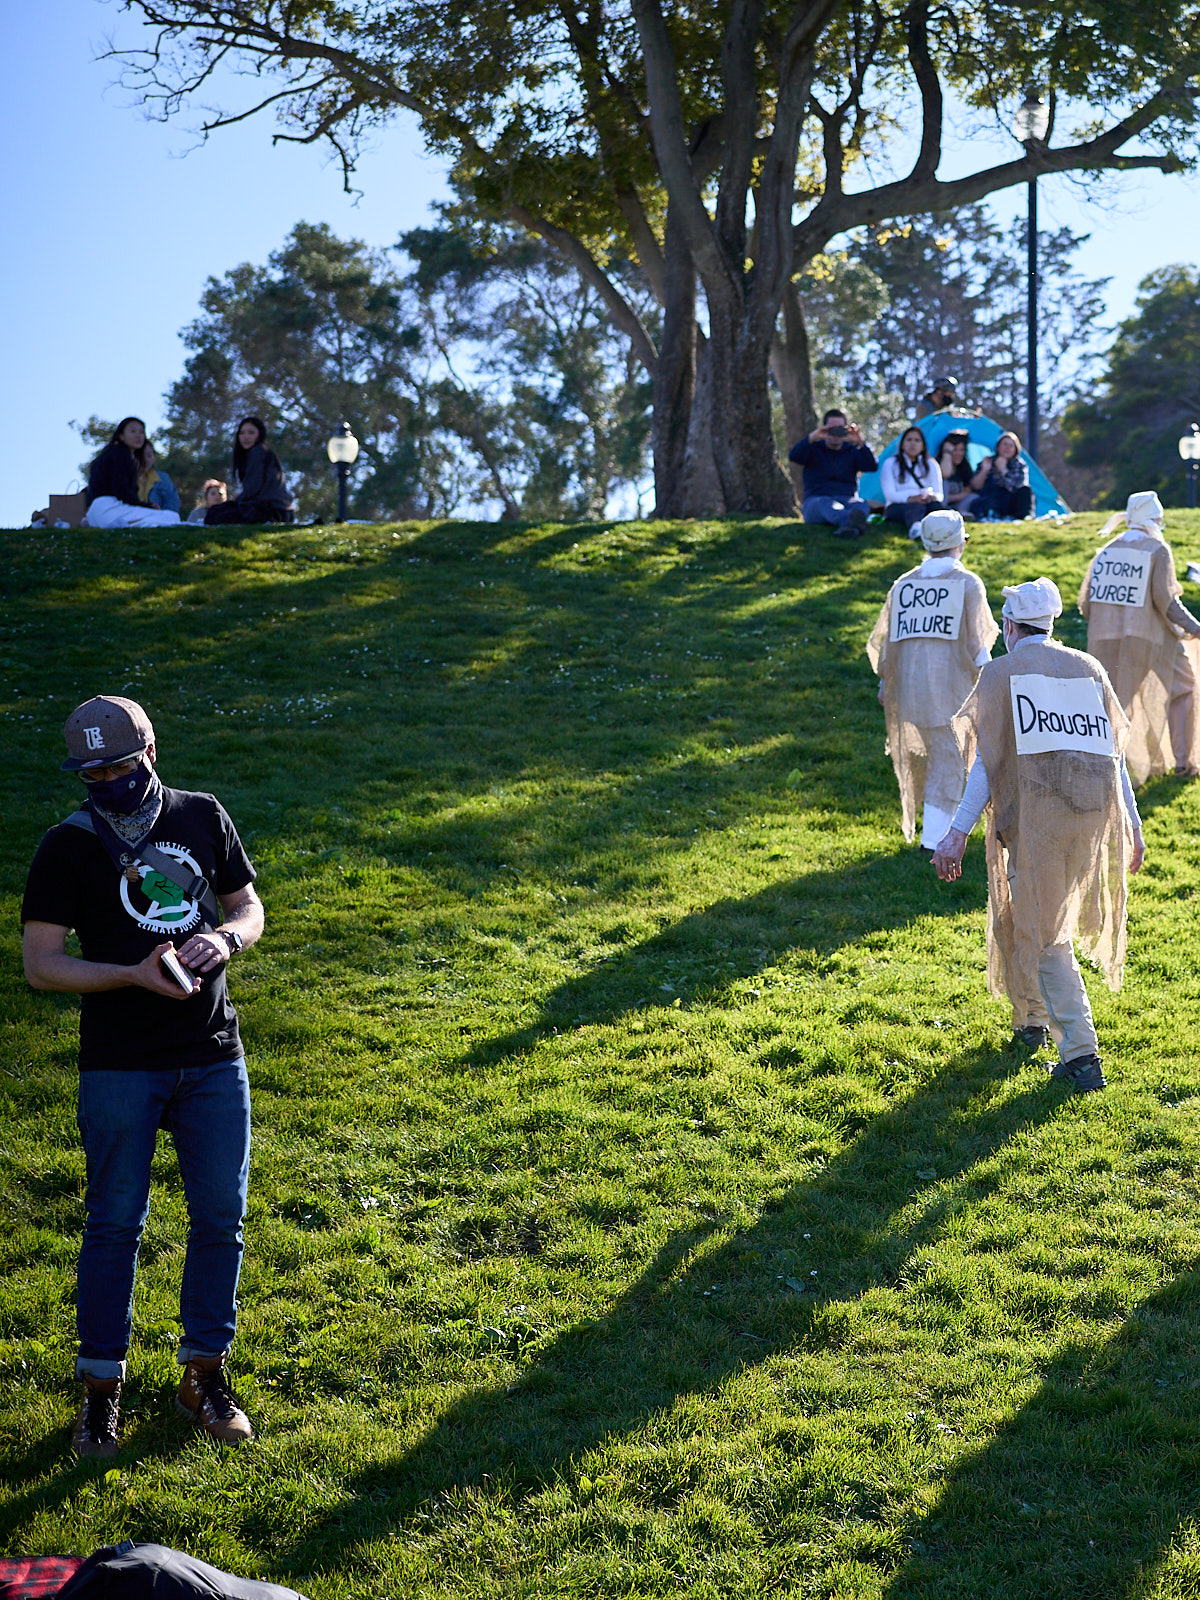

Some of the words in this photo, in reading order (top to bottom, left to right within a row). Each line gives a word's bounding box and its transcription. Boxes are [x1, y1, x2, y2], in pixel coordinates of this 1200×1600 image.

[1093, 551, 1143, 579] STORM
[899, 583, 949, 609] CROP
[896, 610, 954, 639] FAILURE
[1016, 694, 1108, 740] DROUGHT
[155, 841, 192, 855] JUSTICE
[137, 921, 177, 935] CLIMATE
